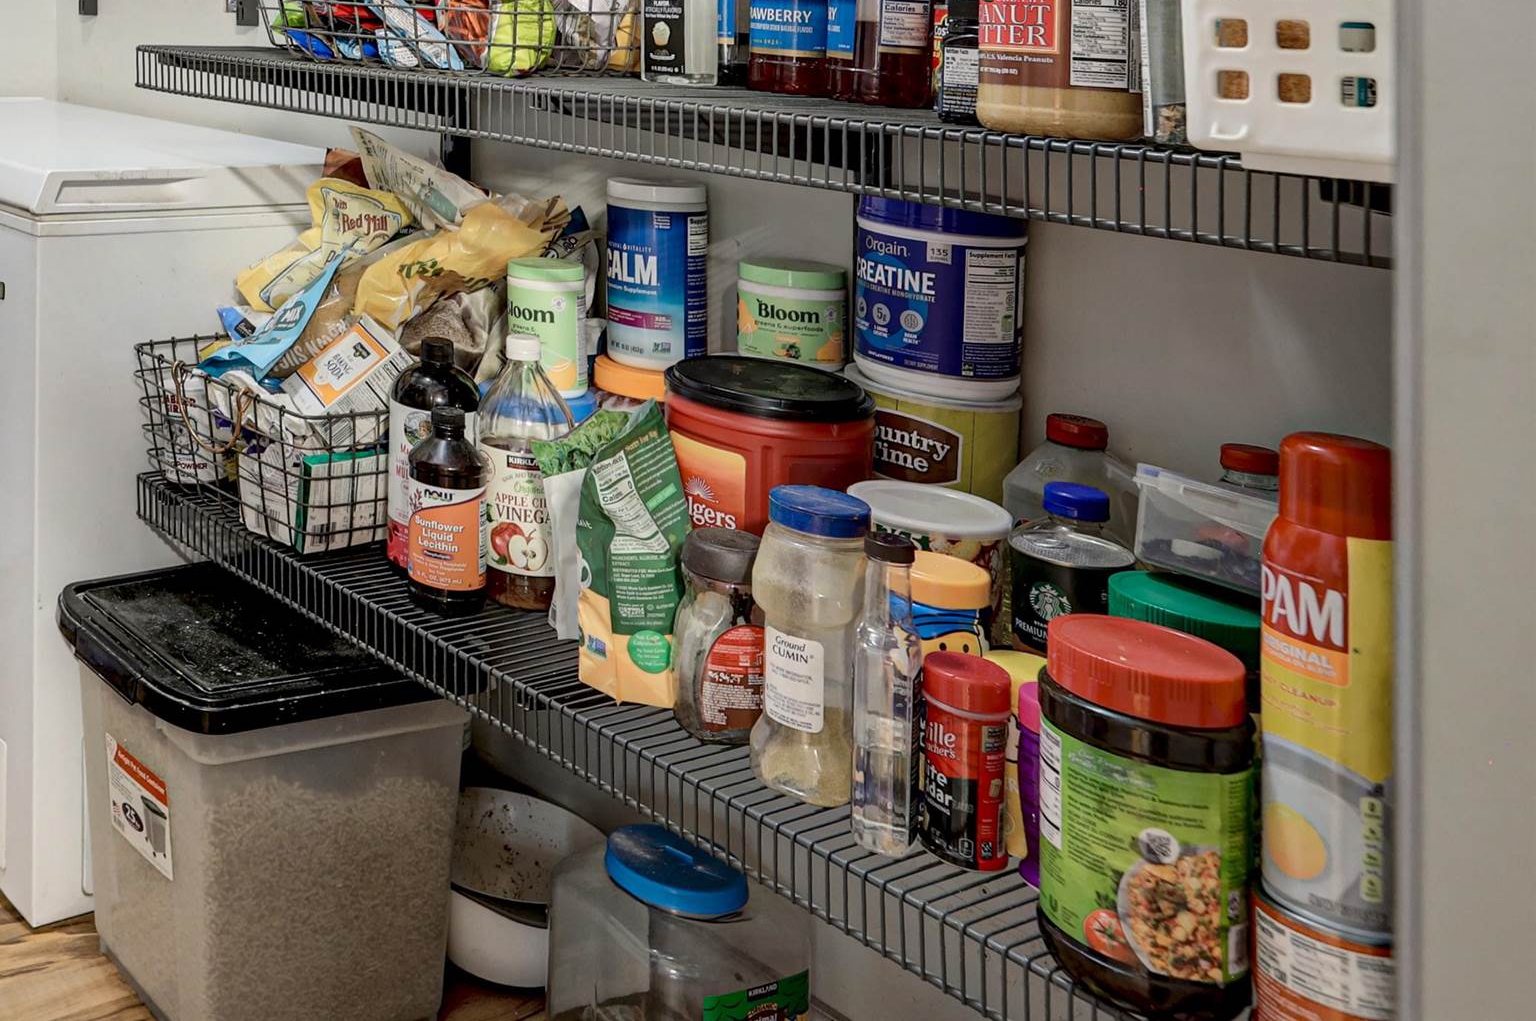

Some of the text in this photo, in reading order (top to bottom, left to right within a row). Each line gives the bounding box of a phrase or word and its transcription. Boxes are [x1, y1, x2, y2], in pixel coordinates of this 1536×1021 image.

[884, 5, 916, 13] Calories
[997, 54, 1023, 62] Valencia
[1023, 55, 1054, 64] Peanuts
[342, 213, 388, 236] Red Mill
[626, 244, 652, 253] VITALITY
[865, 235, 907, 257] Orgain
[930, 247, 949, 258] 135
[969, 251, 1004, 259] Supplement
[607, 248, 658, 286] CALM
[857, 255, 936, 295] CREATINE
[624, 286, 657, 296] Supplement
[891, 289, 936, 304] MONOHYDRATE
[756, 298, 820, 324] Bloom
[876, 306, 887, 322] 5g
[754, 319, 776, 328] greens
[783, 324, 824, 333] superfoods
[325, 359, 345, 381] SODA
[332, 353, 354, 375] BAKING
[495, 492, 529, 508] APPLE
[414, 515, 464, 533] Sunflower
[422, 528, 454, 543] Liquid
[418, 536, 459, 553] Lecithin
[1261, 564, 1345, 648] PAM
[775, 635, 806, 653] Ground
[772, 644, 809, 664] CUMIN
[748, 982, 778, 997] KIRKLAND
